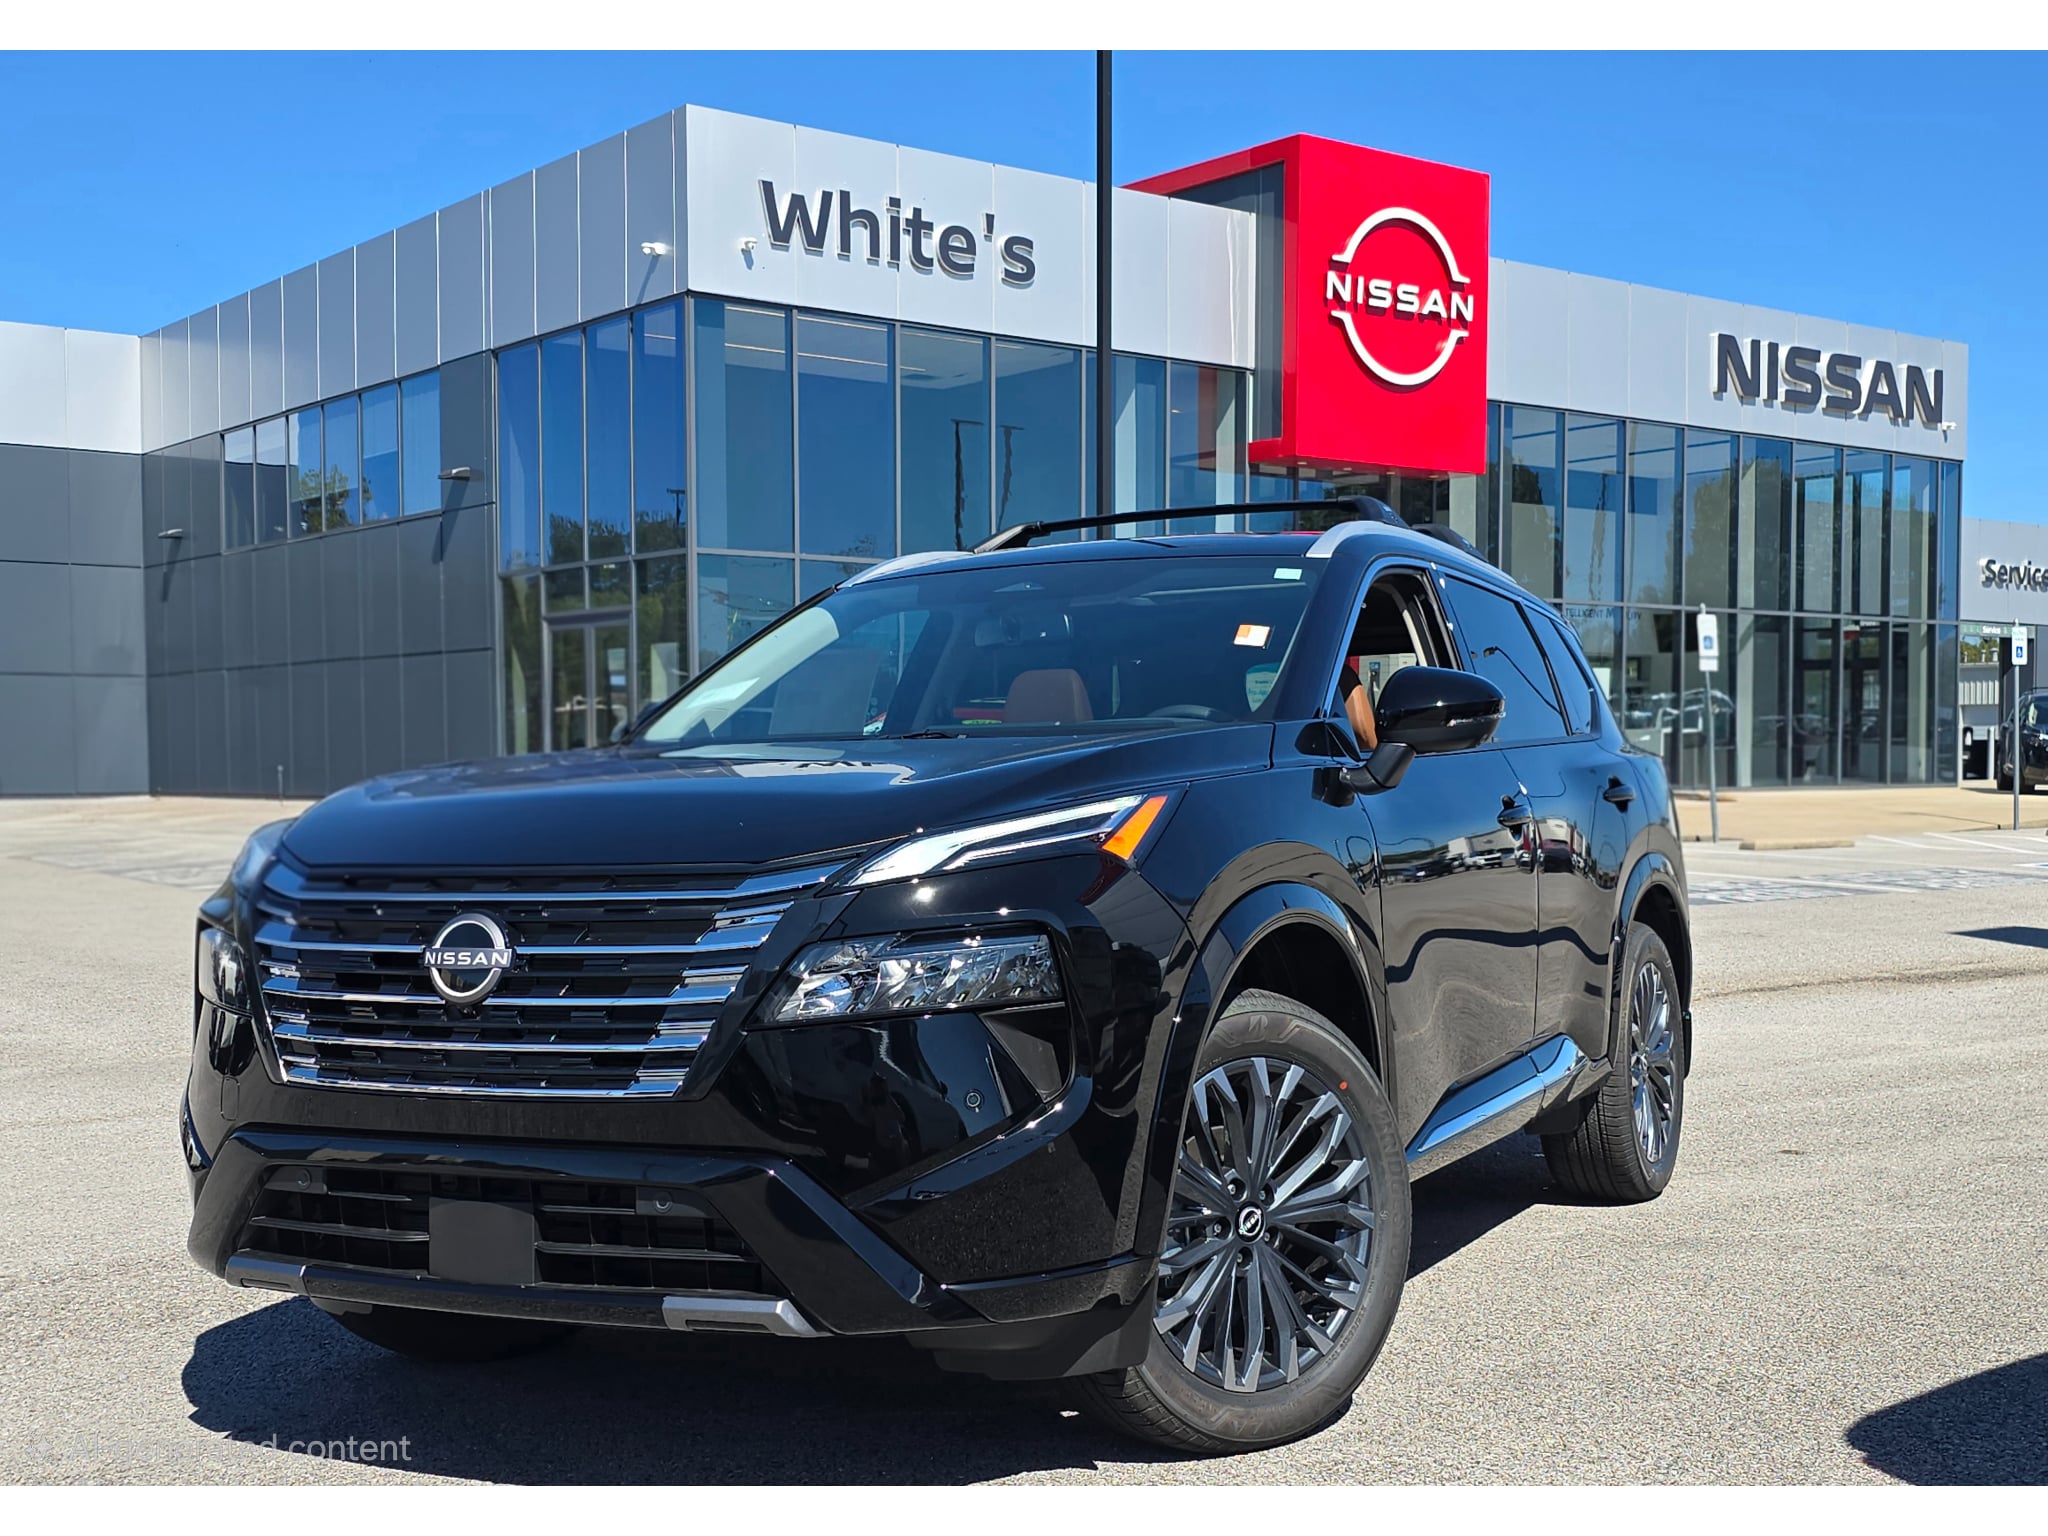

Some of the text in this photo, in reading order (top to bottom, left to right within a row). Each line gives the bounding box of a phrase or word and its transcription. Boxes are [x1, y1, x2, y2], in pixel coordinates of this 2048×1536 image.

[758, 179, 1036, 285] White's
[1326, 270, 1474, 322] NISSAN
[1711, 332, 1944, 428] NISSAN
[425, 951, 509, 966] NISSAN
